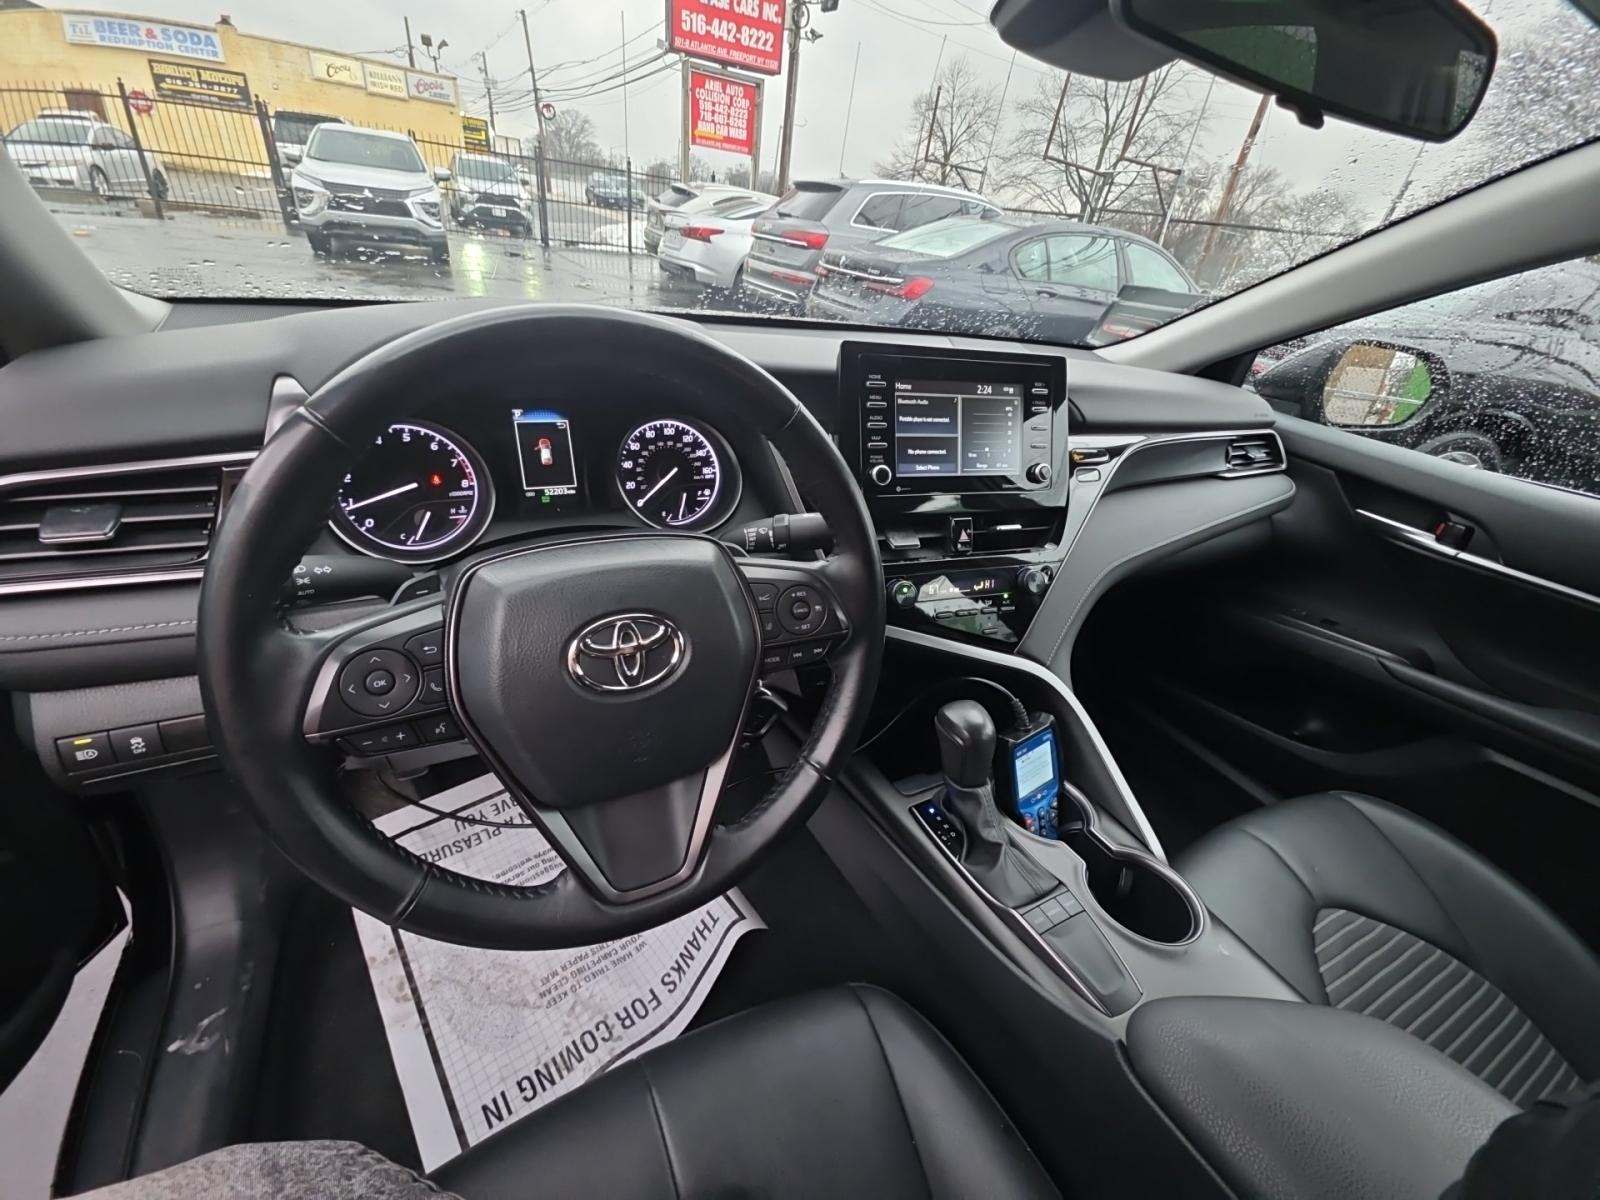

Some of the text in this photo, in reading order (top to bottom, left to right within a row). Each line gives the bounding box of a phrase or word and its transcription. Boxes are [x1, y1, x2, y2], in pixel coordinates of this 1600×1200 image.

[762, 2, 782, 24] INC.
[93, 19, 217, 49] BEER & SODA
[681, 9, 775, 52] 516-442-8222
[100, 34, 219, 58] REDEMPTION CENTER
[696, 87, 731, 105] COLLISION
[725, 83, 744, 97] AUTO
[895, 382, 912, 390] Home
[977, 384, 992, 394] 2:24
[402, 433, 410, 442] 5
[430, 442, 439, 451] 6
[630, 442, 640, 450] 60
[450, 458, 458, 468] 7
[623, 461, 633, 469] 40
[344, 473, 352, 483] 2
[461, 479, 469, 488] 8
[626, 481, 636, 490] 20
[365, 518, 375, 528] 0
[373, 678, 388, 688] OK
[420, 827, 502, 864] PLEASURE
[634, 941, 648, 954] WE
[538, 934, 643, 1000] YOUR CARPETING CLEAN
[540, 943, 612, 987] THIS PAPER MAT
[612, 952, 633, 969] HAVE
[583, 964, 611, 984] TRIED
[570, 980, 584, 994] TO
[545, 990, 569, 1010] KEEP
[480, 910, 720, 1131] THANKS FOR COMING IN
